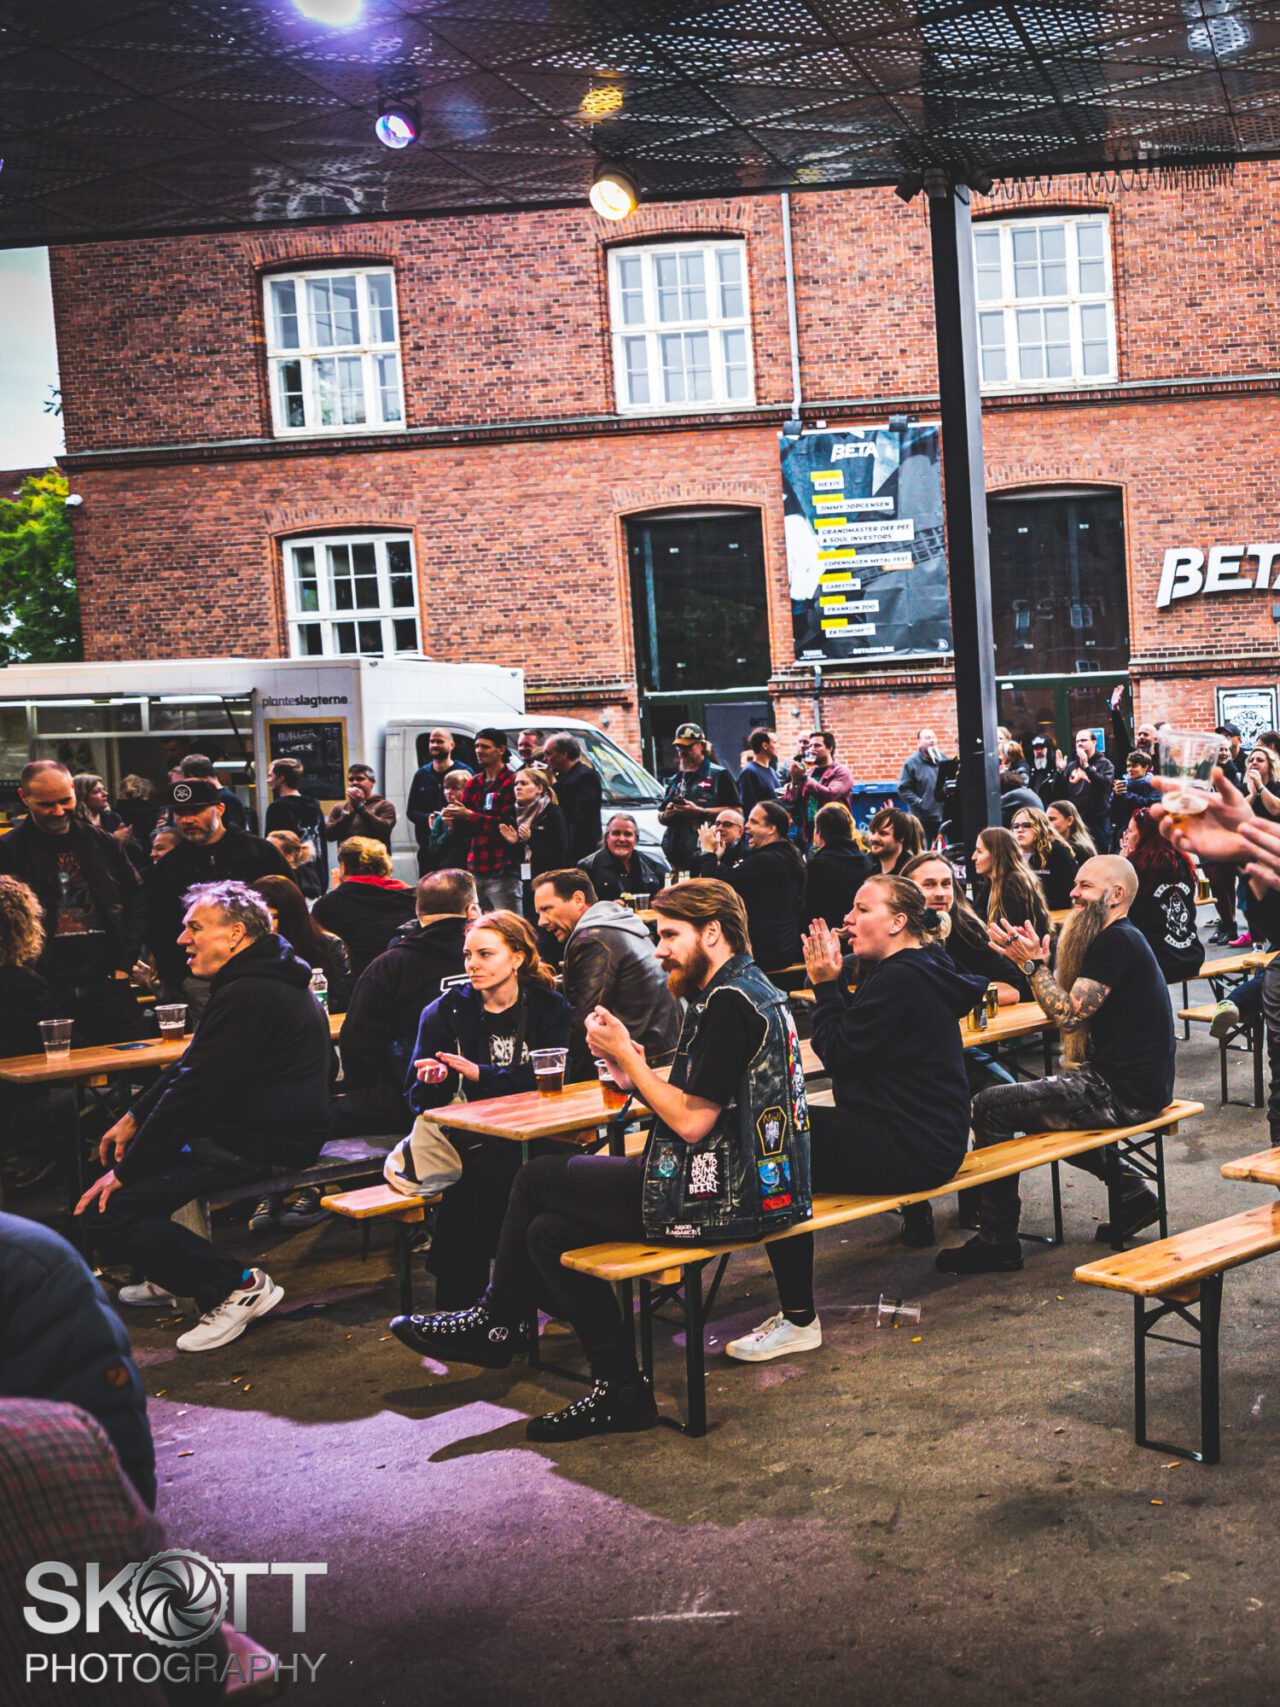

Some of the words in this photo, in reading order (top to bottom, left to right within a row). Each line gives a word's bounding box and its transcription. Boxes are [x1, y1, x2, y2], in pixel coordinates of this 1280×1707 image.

[831, 441, 879, 463] BETA
[820, 504, 844, 512] JIMMY
[822, 525, 879, 535] GRANDMASTER
[850, 534, 893, 542] INVESTORS
[262, 695, 348, 709] planteslagterne
[278, 730, 317, 742] BURGER
[691, 1165, 718, 1178] DRINK
[692, 1174, 720, 1186] YOUR
